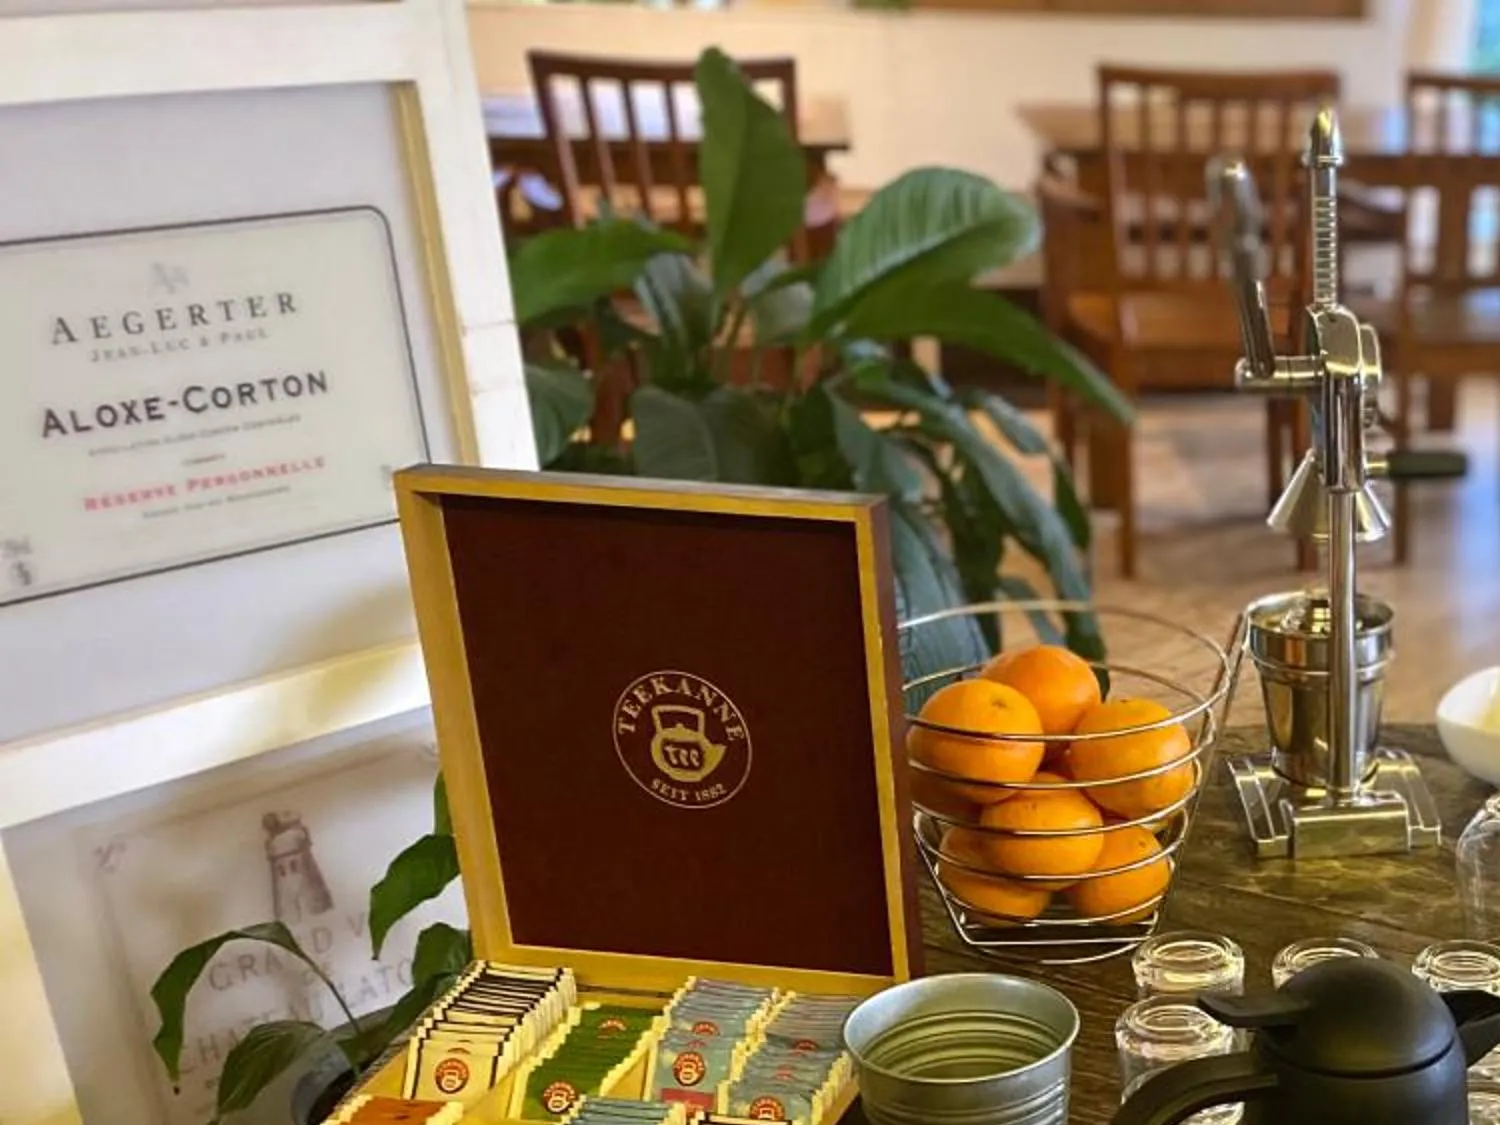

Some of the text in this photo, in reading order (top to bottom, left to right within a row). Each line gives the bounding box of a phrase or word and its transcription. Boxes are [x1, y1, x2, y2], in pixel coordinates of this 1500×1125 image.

[51, 292, 297, 346] AEGERTER
[41, 369, 330, 439] ALOXE-CORTON
[616, 676, 745, 742] TEEKANNE
[651, 778, 689, 801] SEIT
